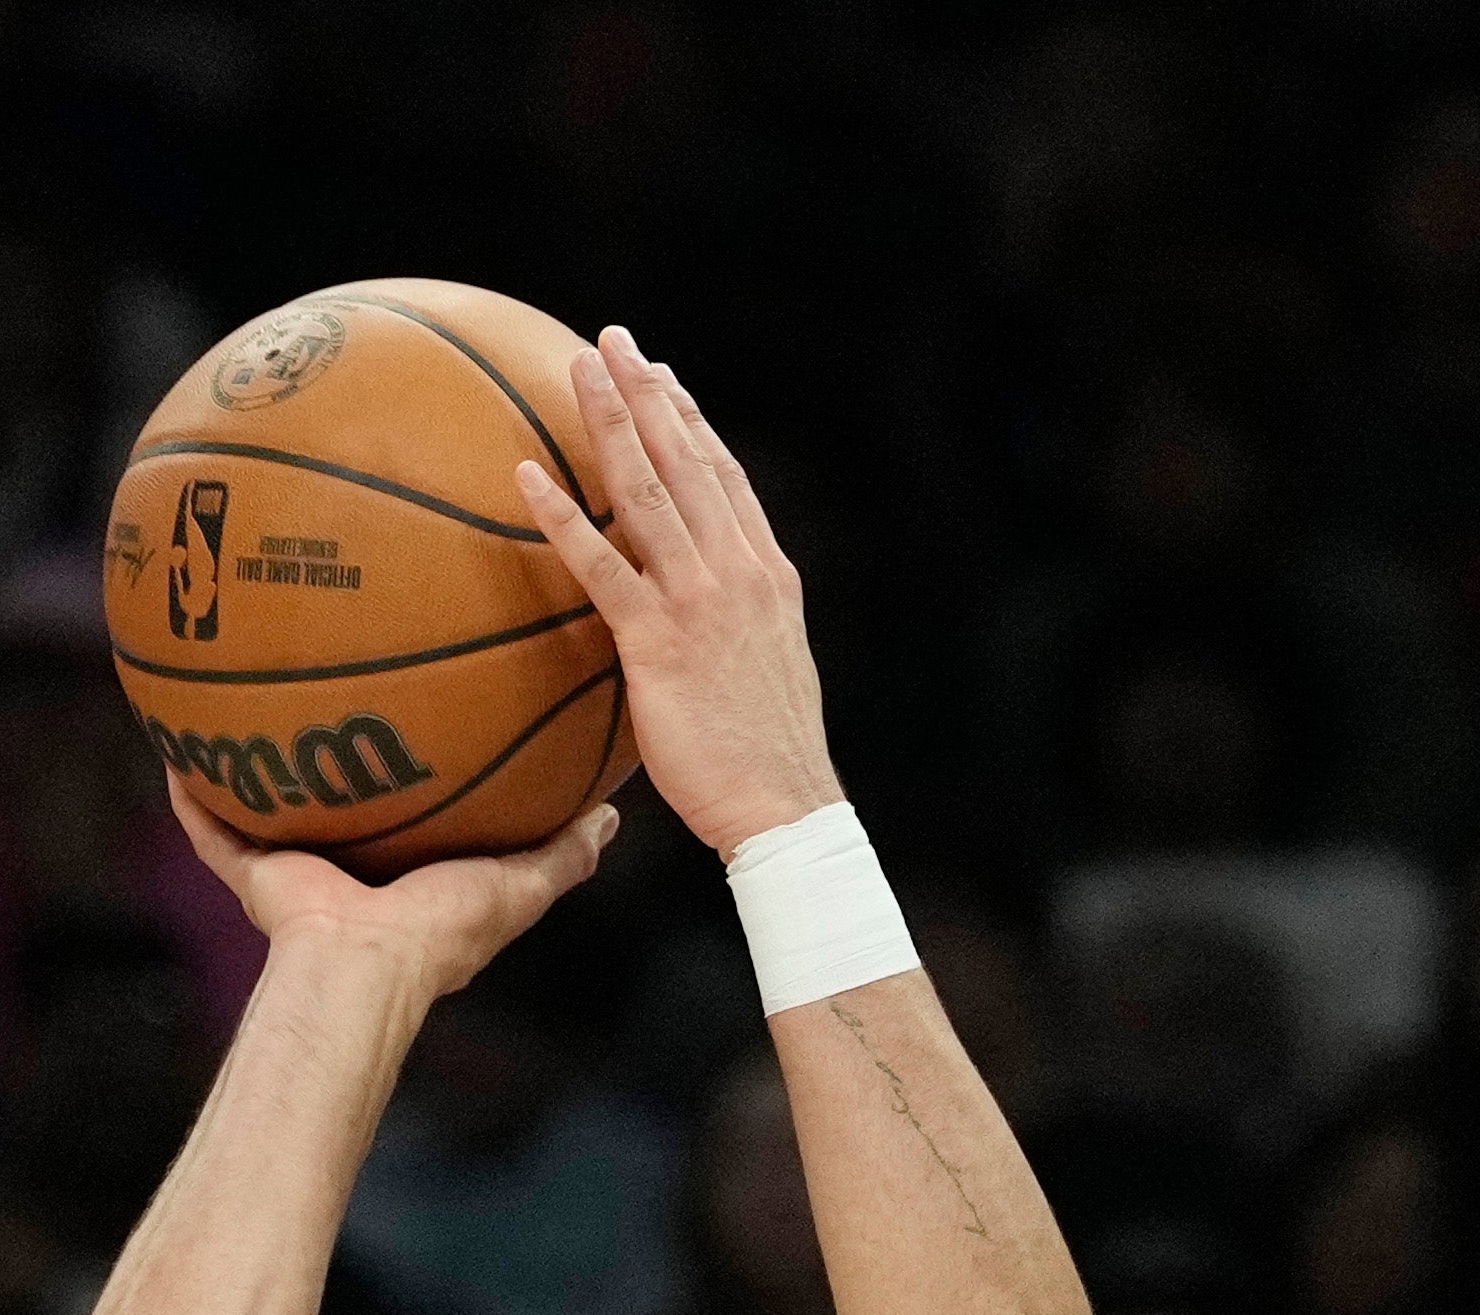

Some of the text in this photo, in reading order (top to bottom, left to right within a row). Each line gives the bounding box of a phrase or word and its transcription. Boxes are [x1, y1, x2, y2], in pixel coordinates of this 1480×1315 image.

[235, 556, 362, 590] OFFICIAL GAME BALL
[133, 712, 436, 816] Wilso
